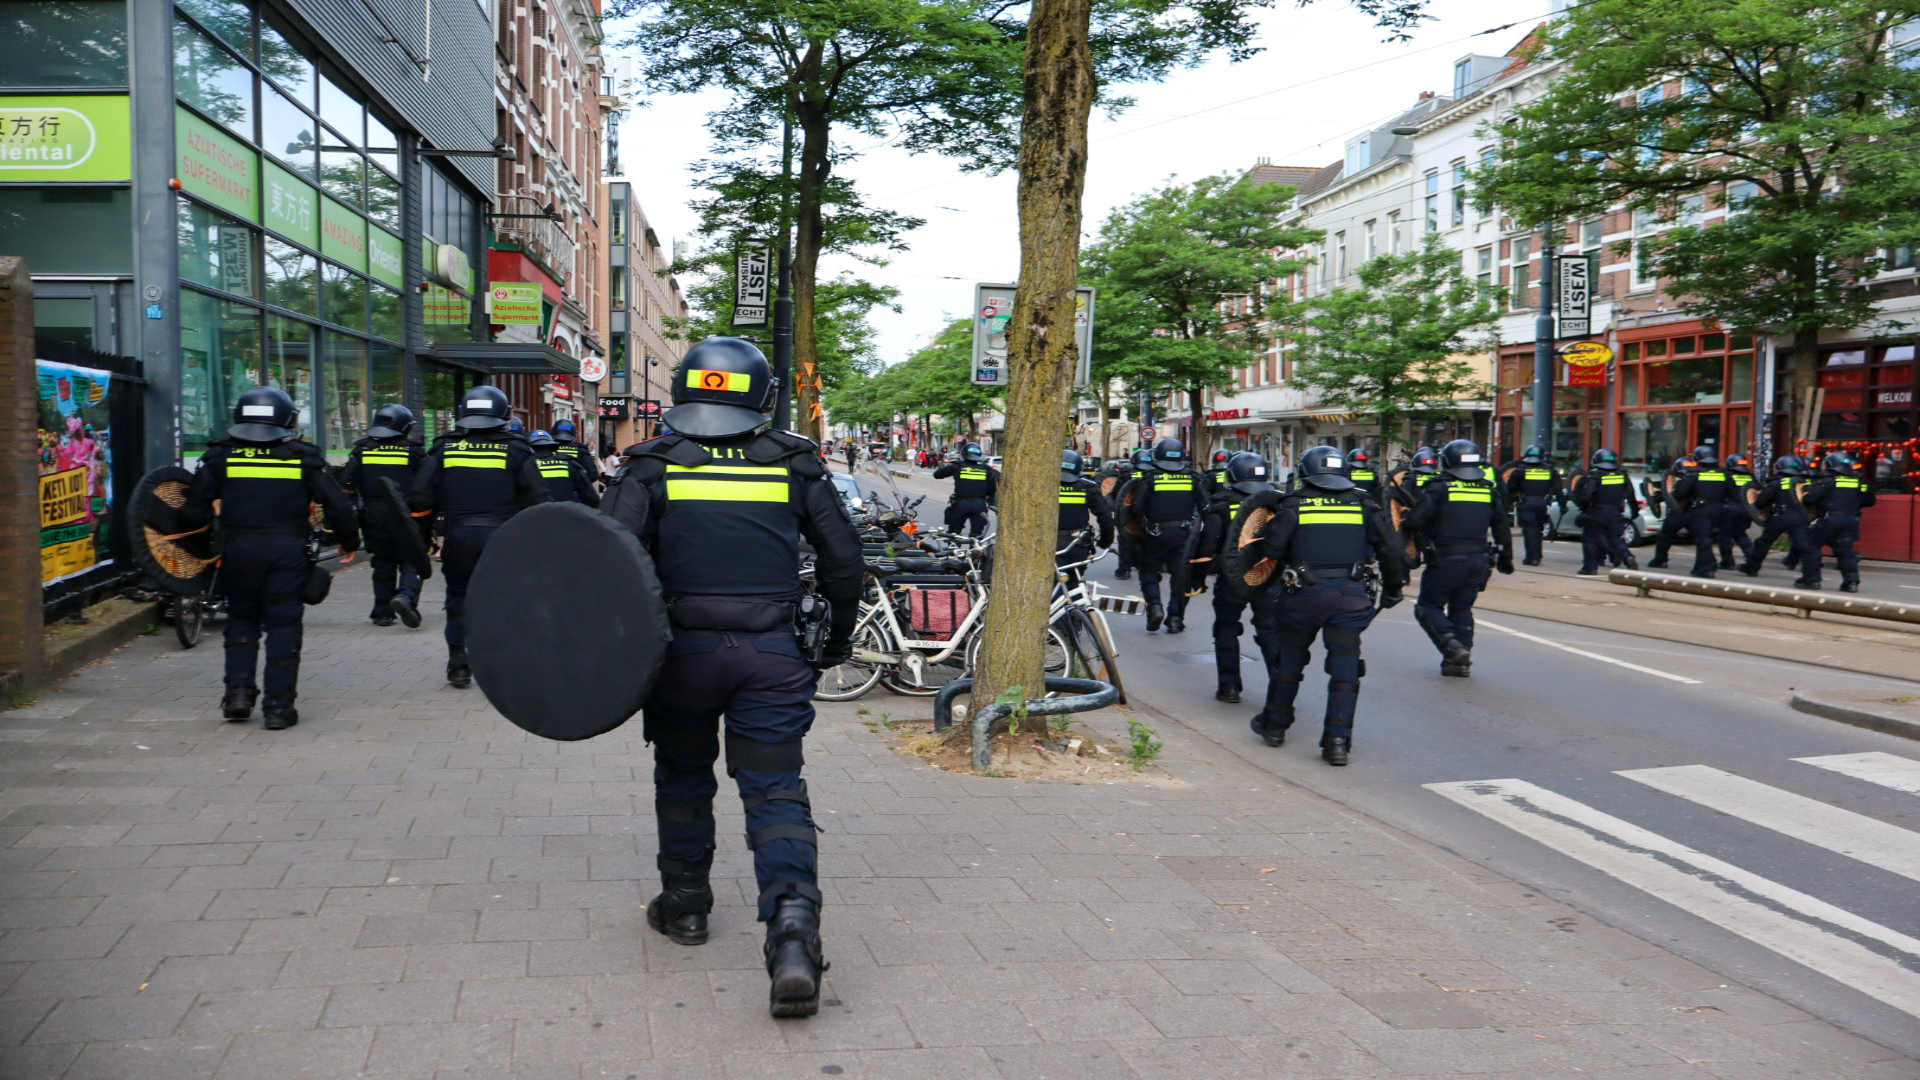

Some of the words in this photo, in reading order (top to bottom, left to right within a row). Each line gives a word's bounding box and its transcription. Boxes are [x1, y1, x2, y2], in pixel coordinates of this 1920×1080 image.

[0, 116, 60, 136] 方行
[187, 130, 246, 177] AZIATISCHE
[182, 156, 251, 204] SUPERMARKT
[271, 181, 310, 232] 東方行
[324, 217, 363, 253] AMAZING
[369, 239, 402, 275] Oriental
[494, 304, 537, 312] Aziatische
[493, 313, 539, 321] Supermarkt
[1561, 321, 1586, 329] ECHT
[599, 398, 625, 406] Food
[1878, 392, 1912, 403] WELKOM
[451, 439, 500, 450] POLITIE
[236, 448, 271, 457] POLI
[42, 493, 86, 523] FESTIVAL
